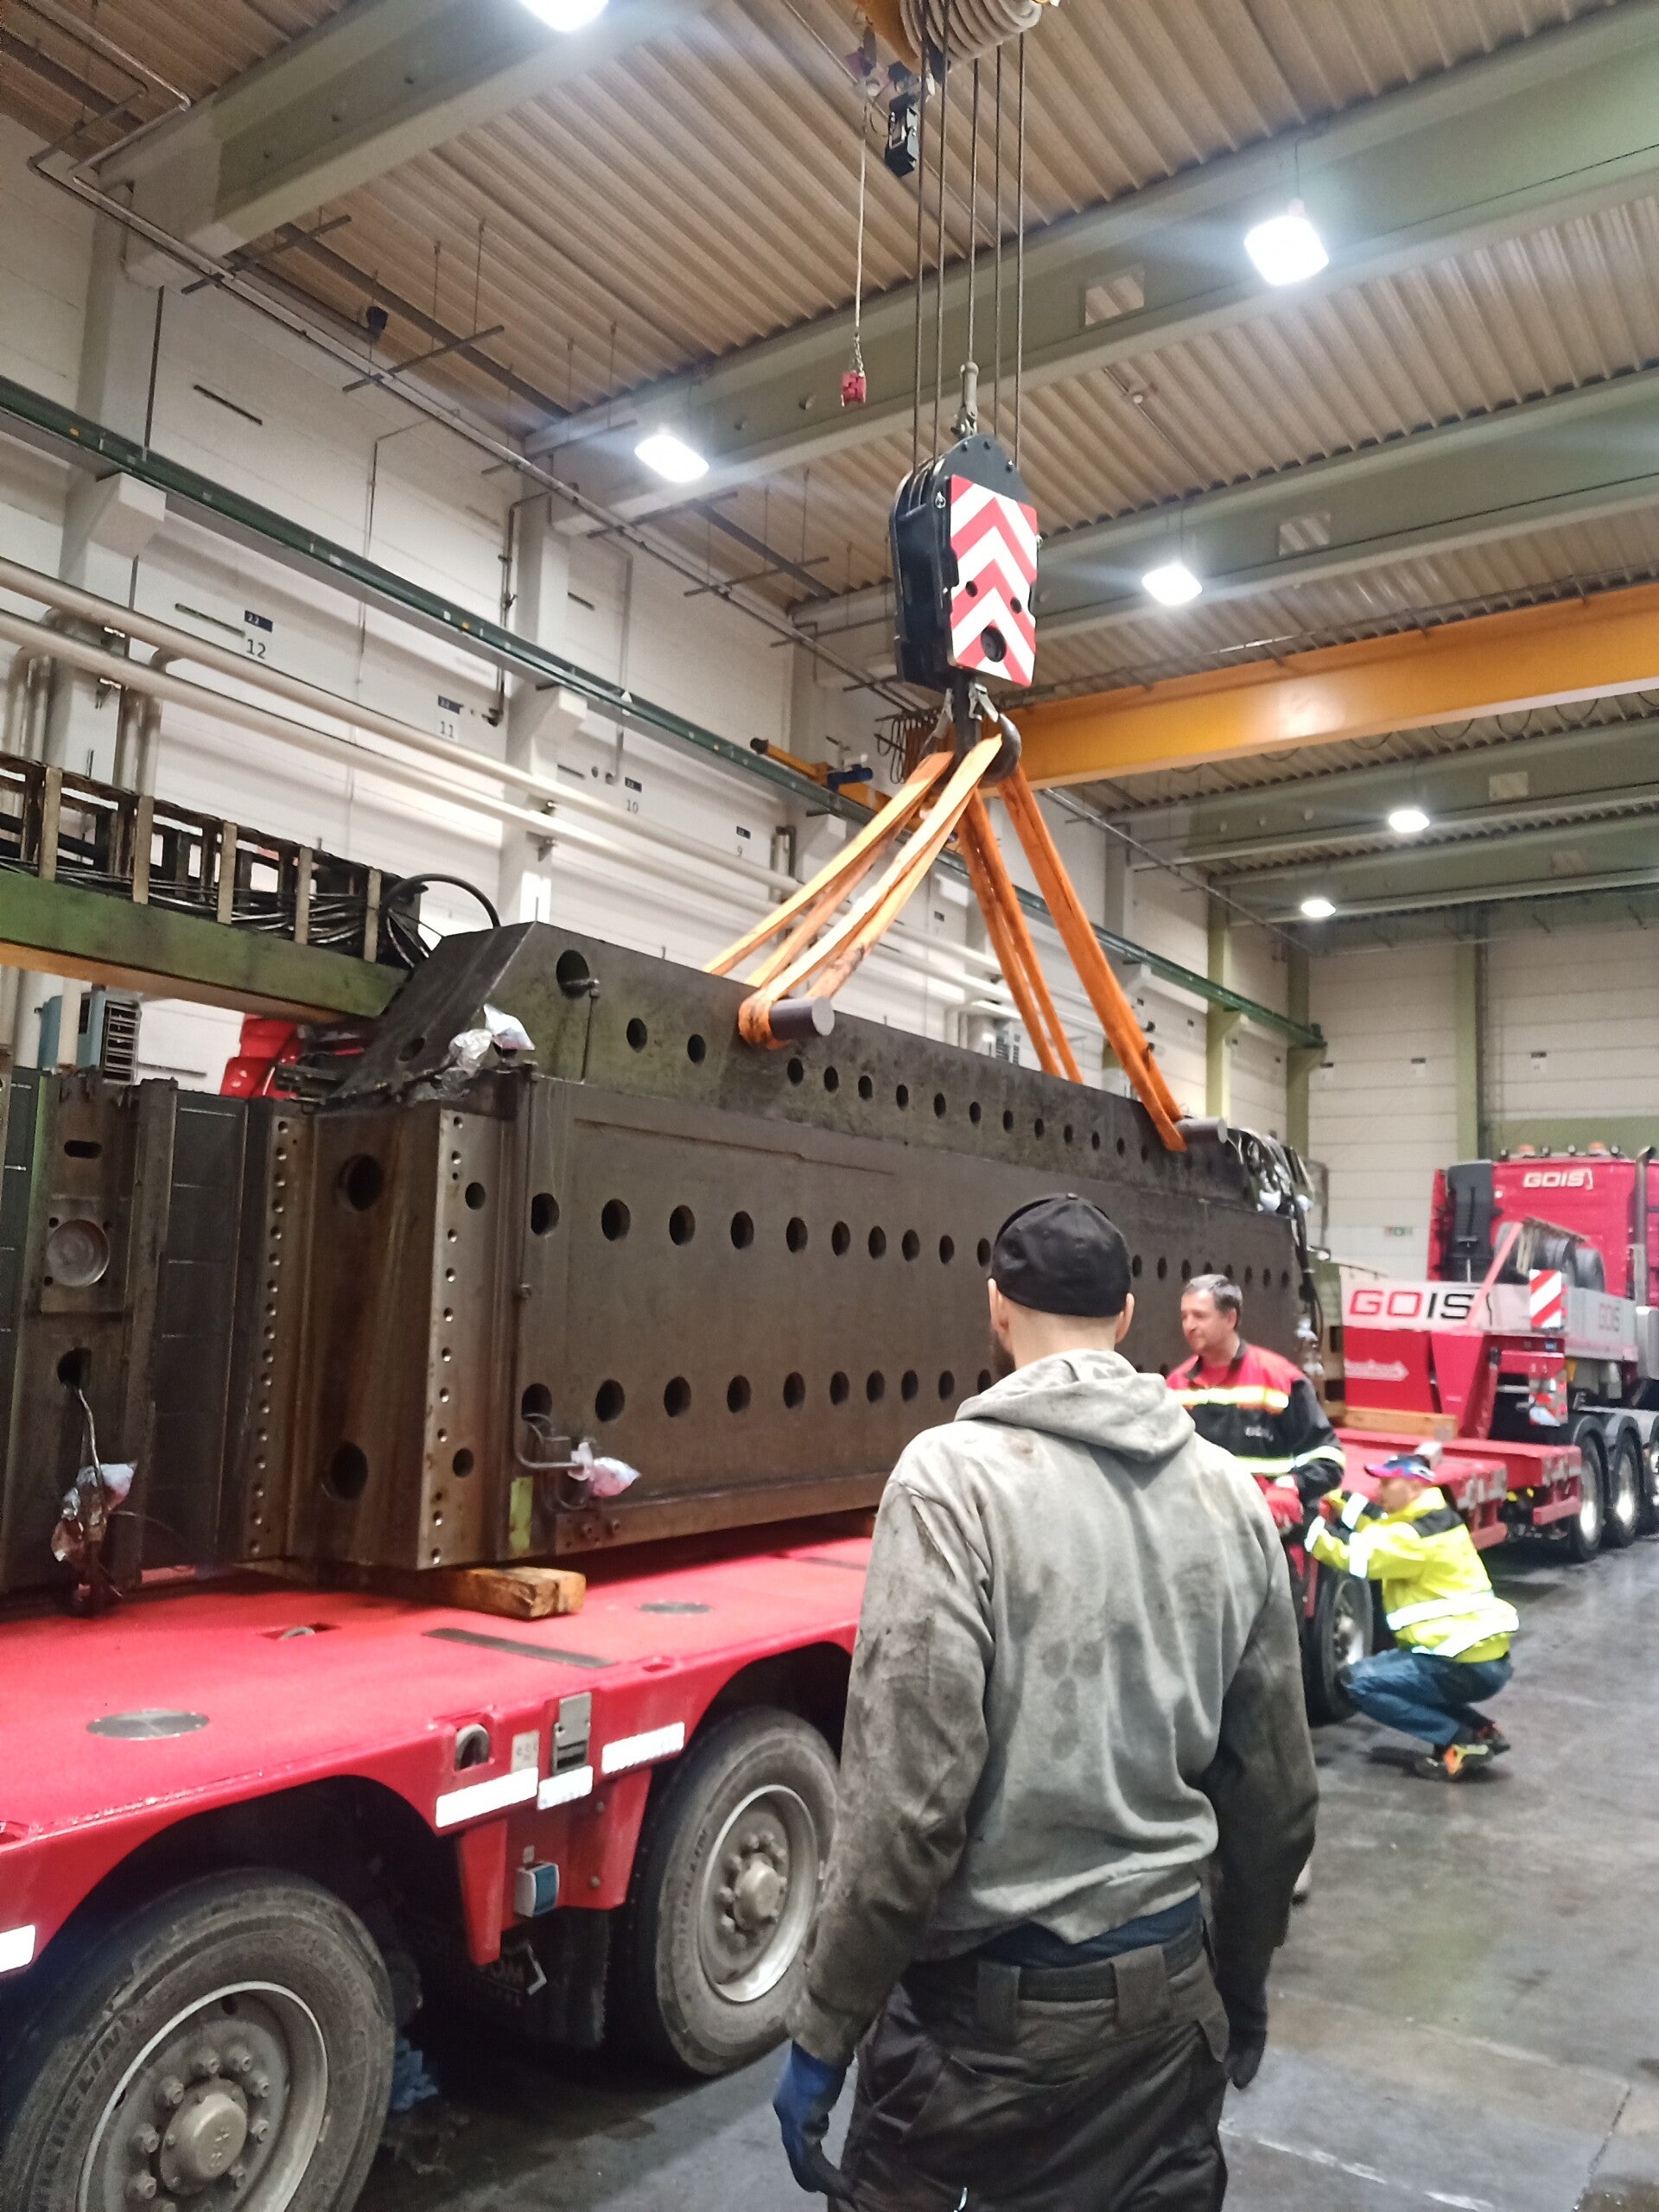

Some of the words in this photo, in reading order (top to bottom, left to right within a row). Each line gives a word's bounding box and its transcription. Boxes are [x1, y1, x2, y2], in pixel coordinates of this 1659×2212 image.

[246, 639, 266, 659] 12
[440, 721, 454, 739] 11
[626, 798, 639, 814] 10
[1523, 1170, 1585, 1188] GOIS
[1350, 1289, 1475, 1320] GOIS
